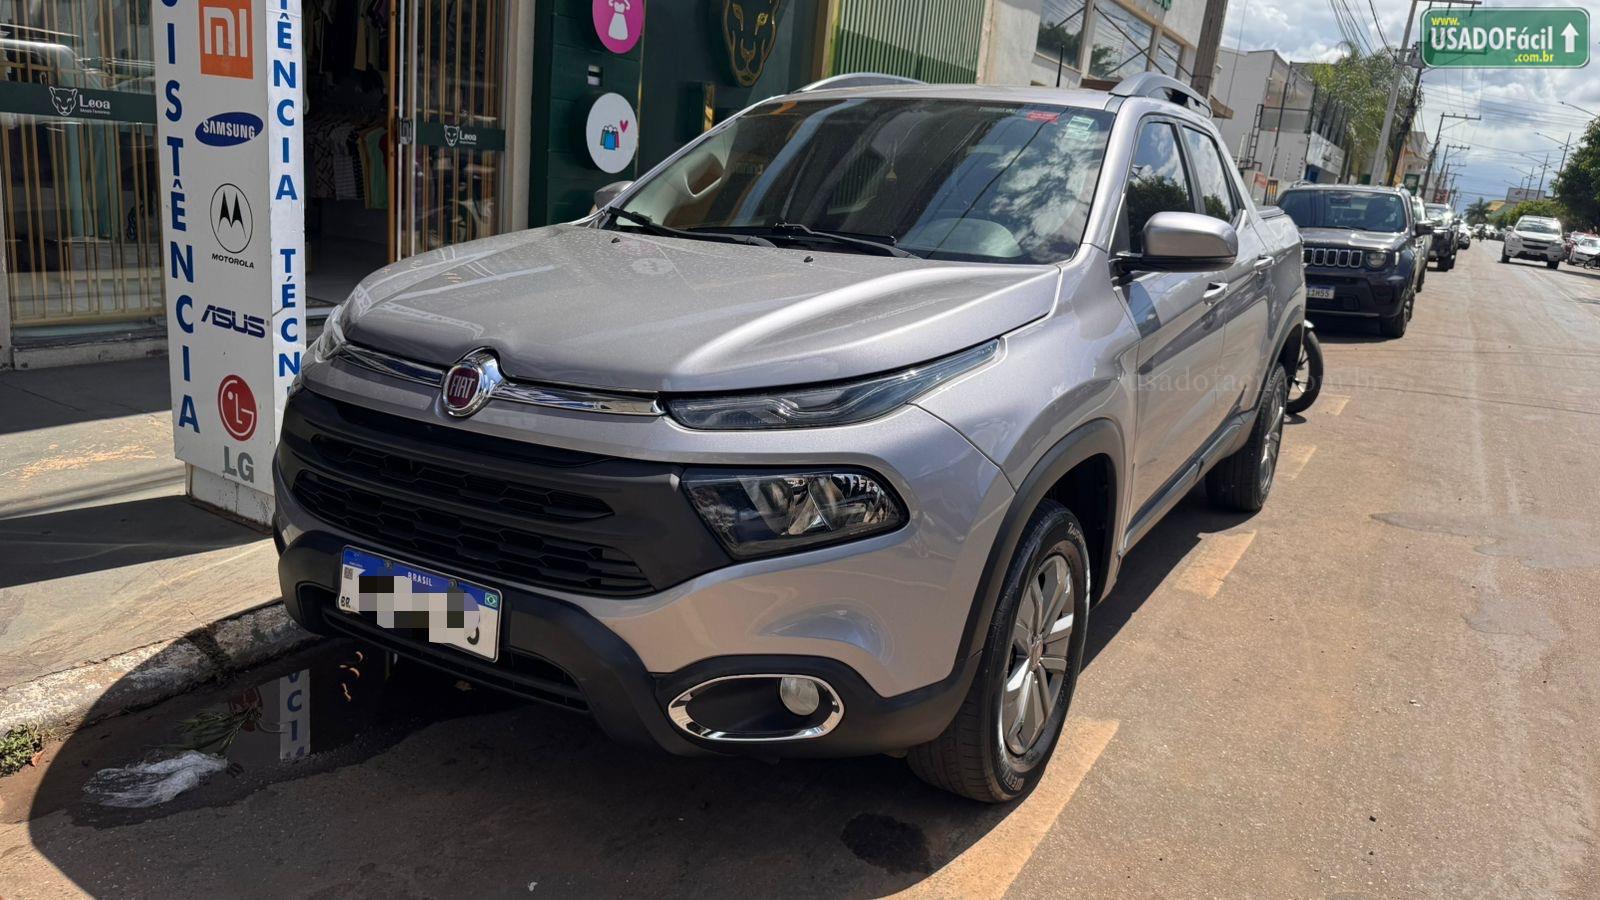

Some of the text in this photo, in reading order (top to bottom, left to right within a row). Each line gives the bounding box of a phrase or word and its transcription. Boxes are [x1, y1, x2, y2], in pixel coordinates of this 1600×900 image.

[79, 94, 110, 110] Leoa
[203, 119, 256, 141] SAMSUNG
[161, 0, 200, 433] ISTÊNCIA
[211, 253, 255, 269] MOTOROLA
[201, 305, 266, 338] ASUS
[278, 248, 300, 398] TÉCN
[449, 375, 476, 399] FIAT
[224, 446, 254, 483] LG
[407, 571, 433, 587] BRASIL
